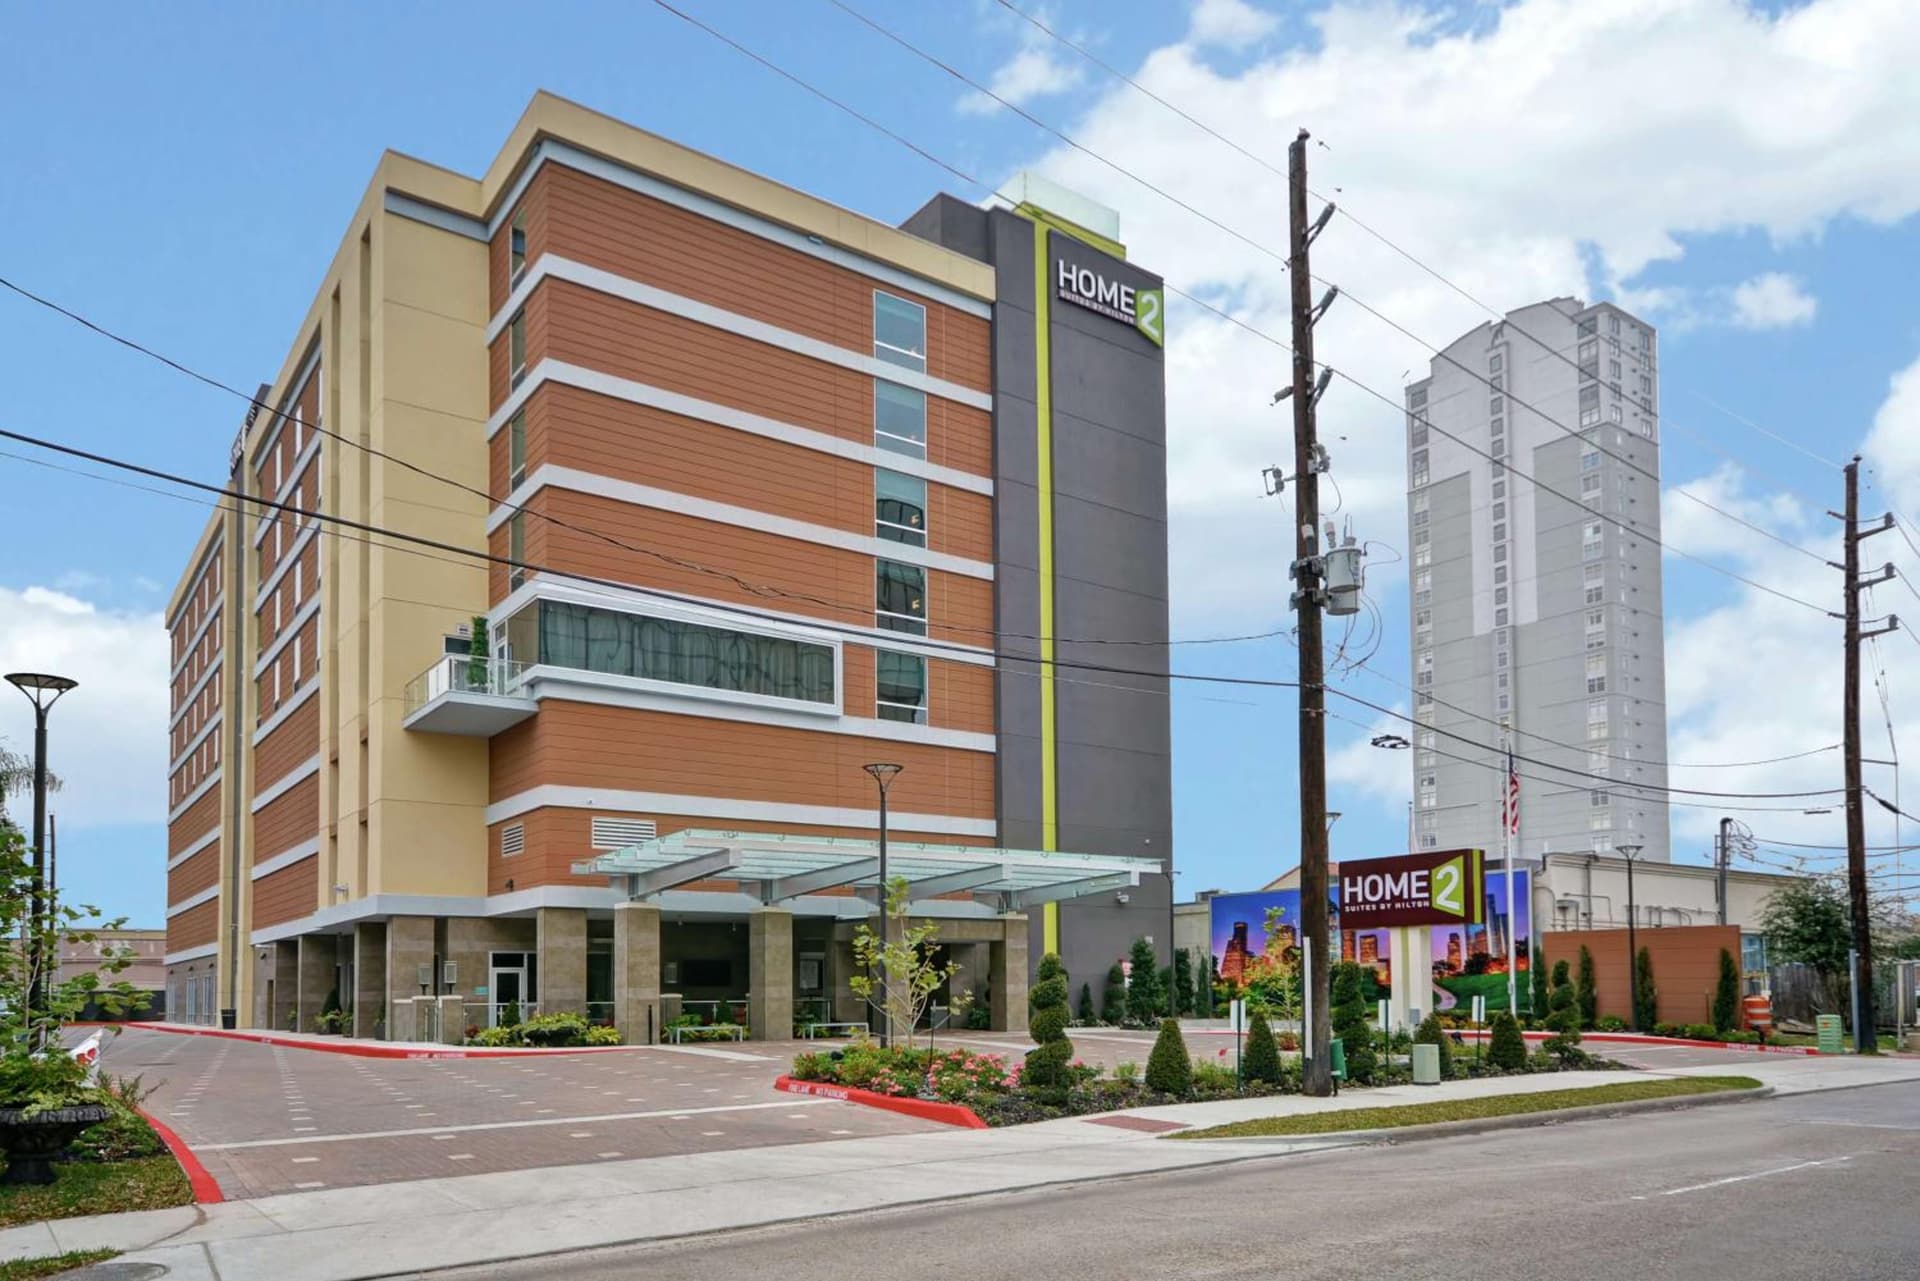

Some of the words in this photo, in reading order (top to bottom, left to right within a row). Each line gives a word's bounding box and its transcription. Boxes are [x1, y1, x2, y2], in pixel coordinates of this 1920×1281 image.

[1058, 259, 1136, 316] HOME
[1141, 293, 1160, 337] 2
[1344, 869, 1430, 904] HOME
[1436, 864, 1460, 911] 2
[1344, 904, 1377, 912] SUITES
[1395, 901, 1430, 910] HILTON
